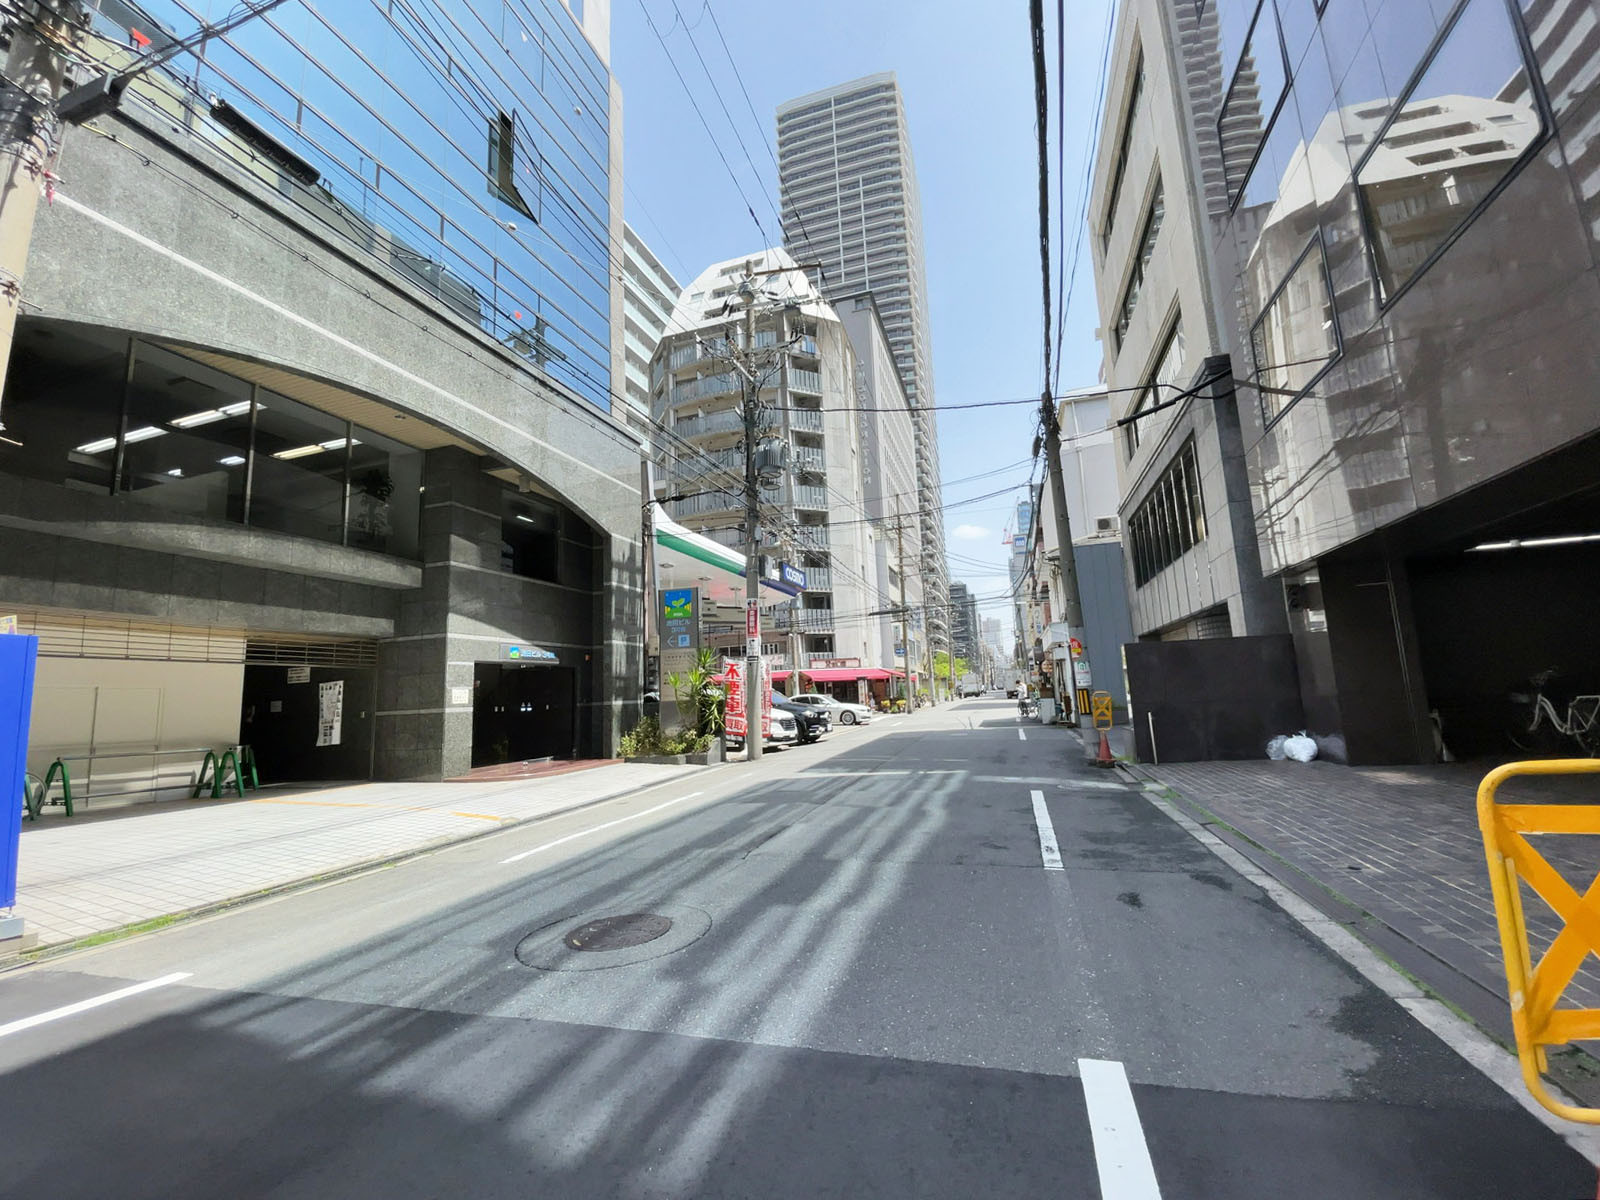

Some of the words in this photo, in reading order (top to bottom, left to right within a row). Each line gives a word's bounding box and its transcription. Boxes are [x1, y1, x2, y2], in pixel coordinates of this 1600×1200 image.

[785, 566, 805, 586] COSMO
[724, 662, 741, 713] 不要車
